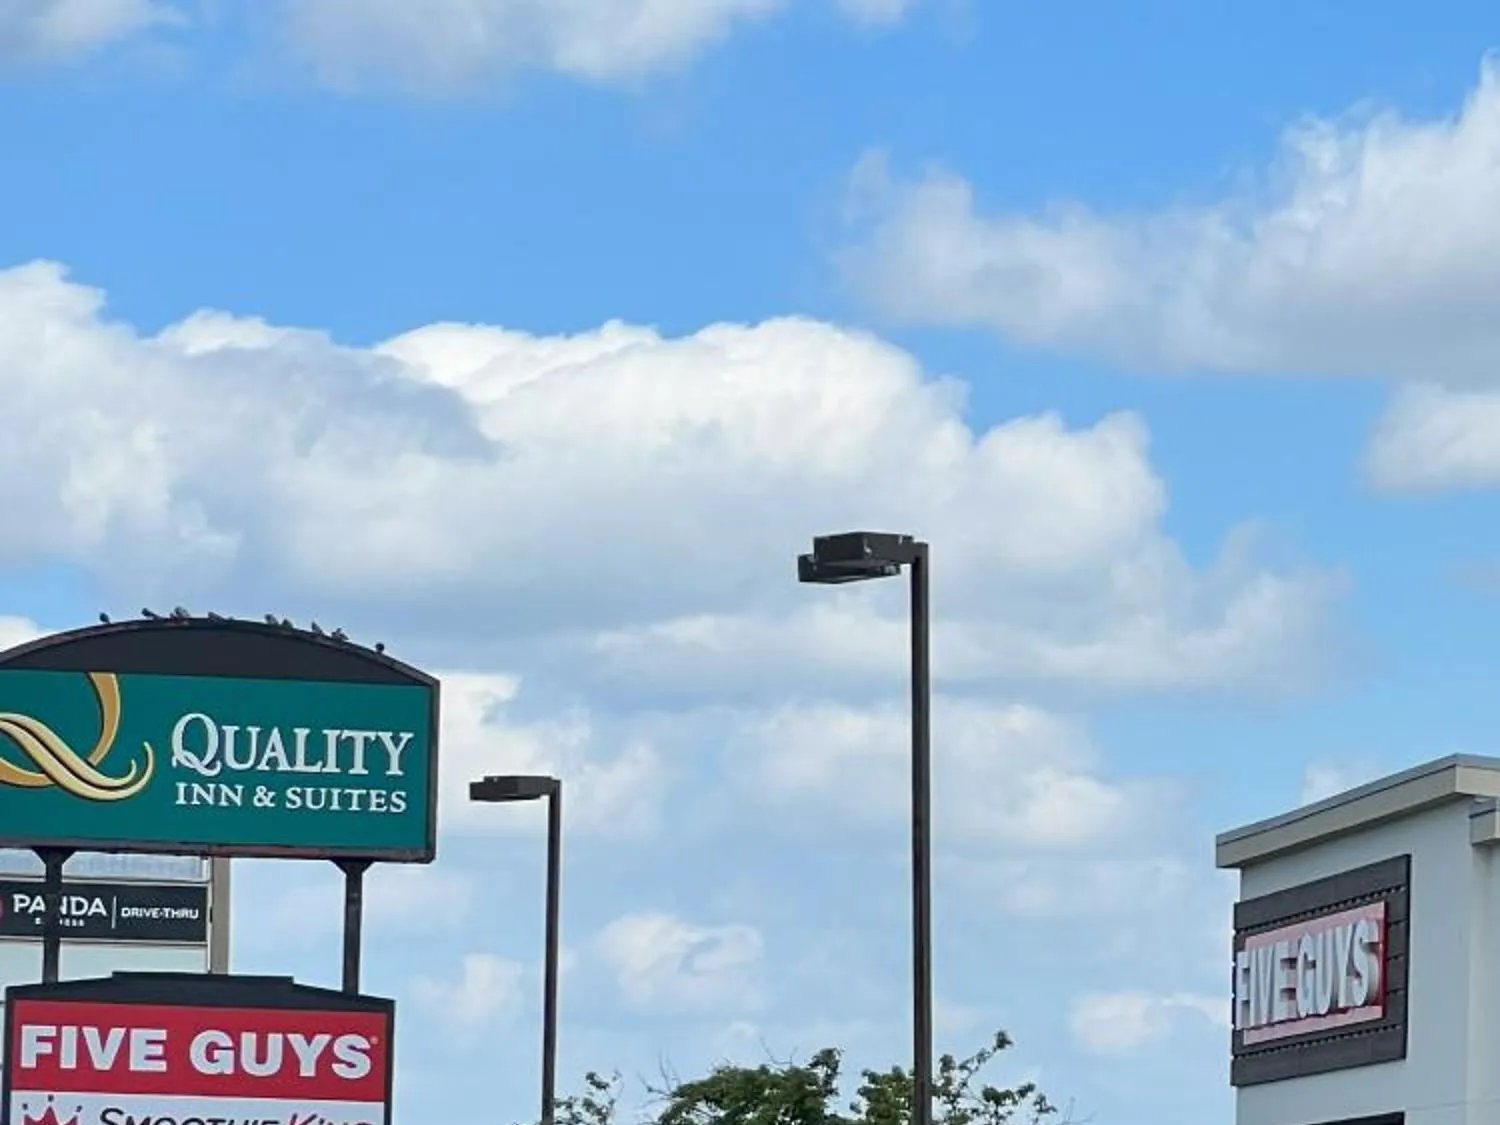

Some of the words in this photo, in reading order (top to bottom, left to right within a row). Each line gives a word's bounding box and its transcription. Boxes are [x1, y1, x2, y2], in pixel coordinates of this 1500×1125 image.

[171, 712, 415, 777] QUALITY
[175, 782, 242, 808] INN
[253, 785, 276, 808] &
[285, 787, 407, 813] SUITES
[121, 906, 199, 919] DRIVE-THRU
[1236, 941, 1297, 1031] FIVE
[1297, 919, 1382, 1019] GUYS
[20, 1024, 167, 1072] FIVE
[189, 1030, 372, 1079] GUYS
